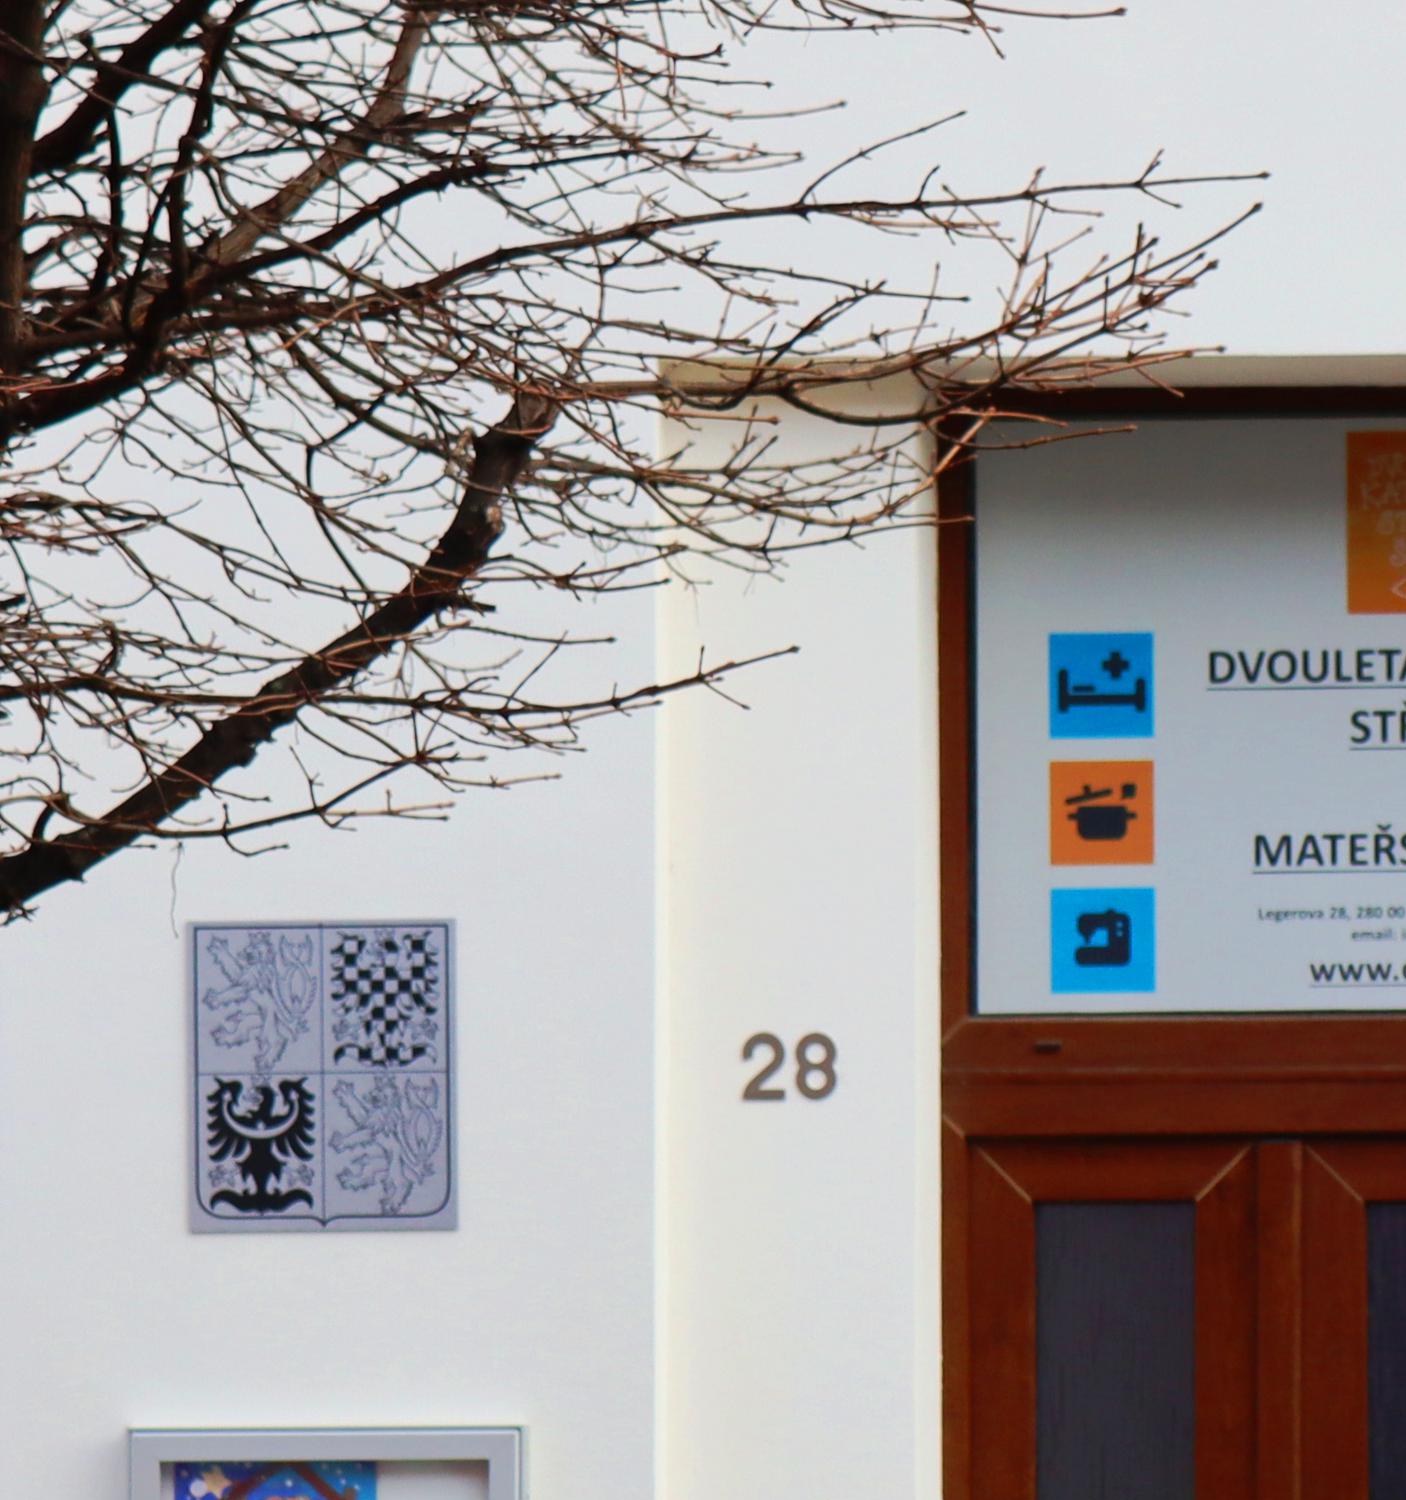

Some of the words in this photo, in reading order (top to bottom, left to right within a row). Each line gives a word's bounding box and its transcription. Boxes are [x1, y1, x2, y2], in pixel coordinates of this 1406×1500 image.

[1258, 907, 1324, 922] Legerova
[1329, 906, 1351, 920] 28,
[1356, 906, 1383, 919] 280
[1386, 905, 1406, 918] 00
[743, 1032, 837, 1100] 28
